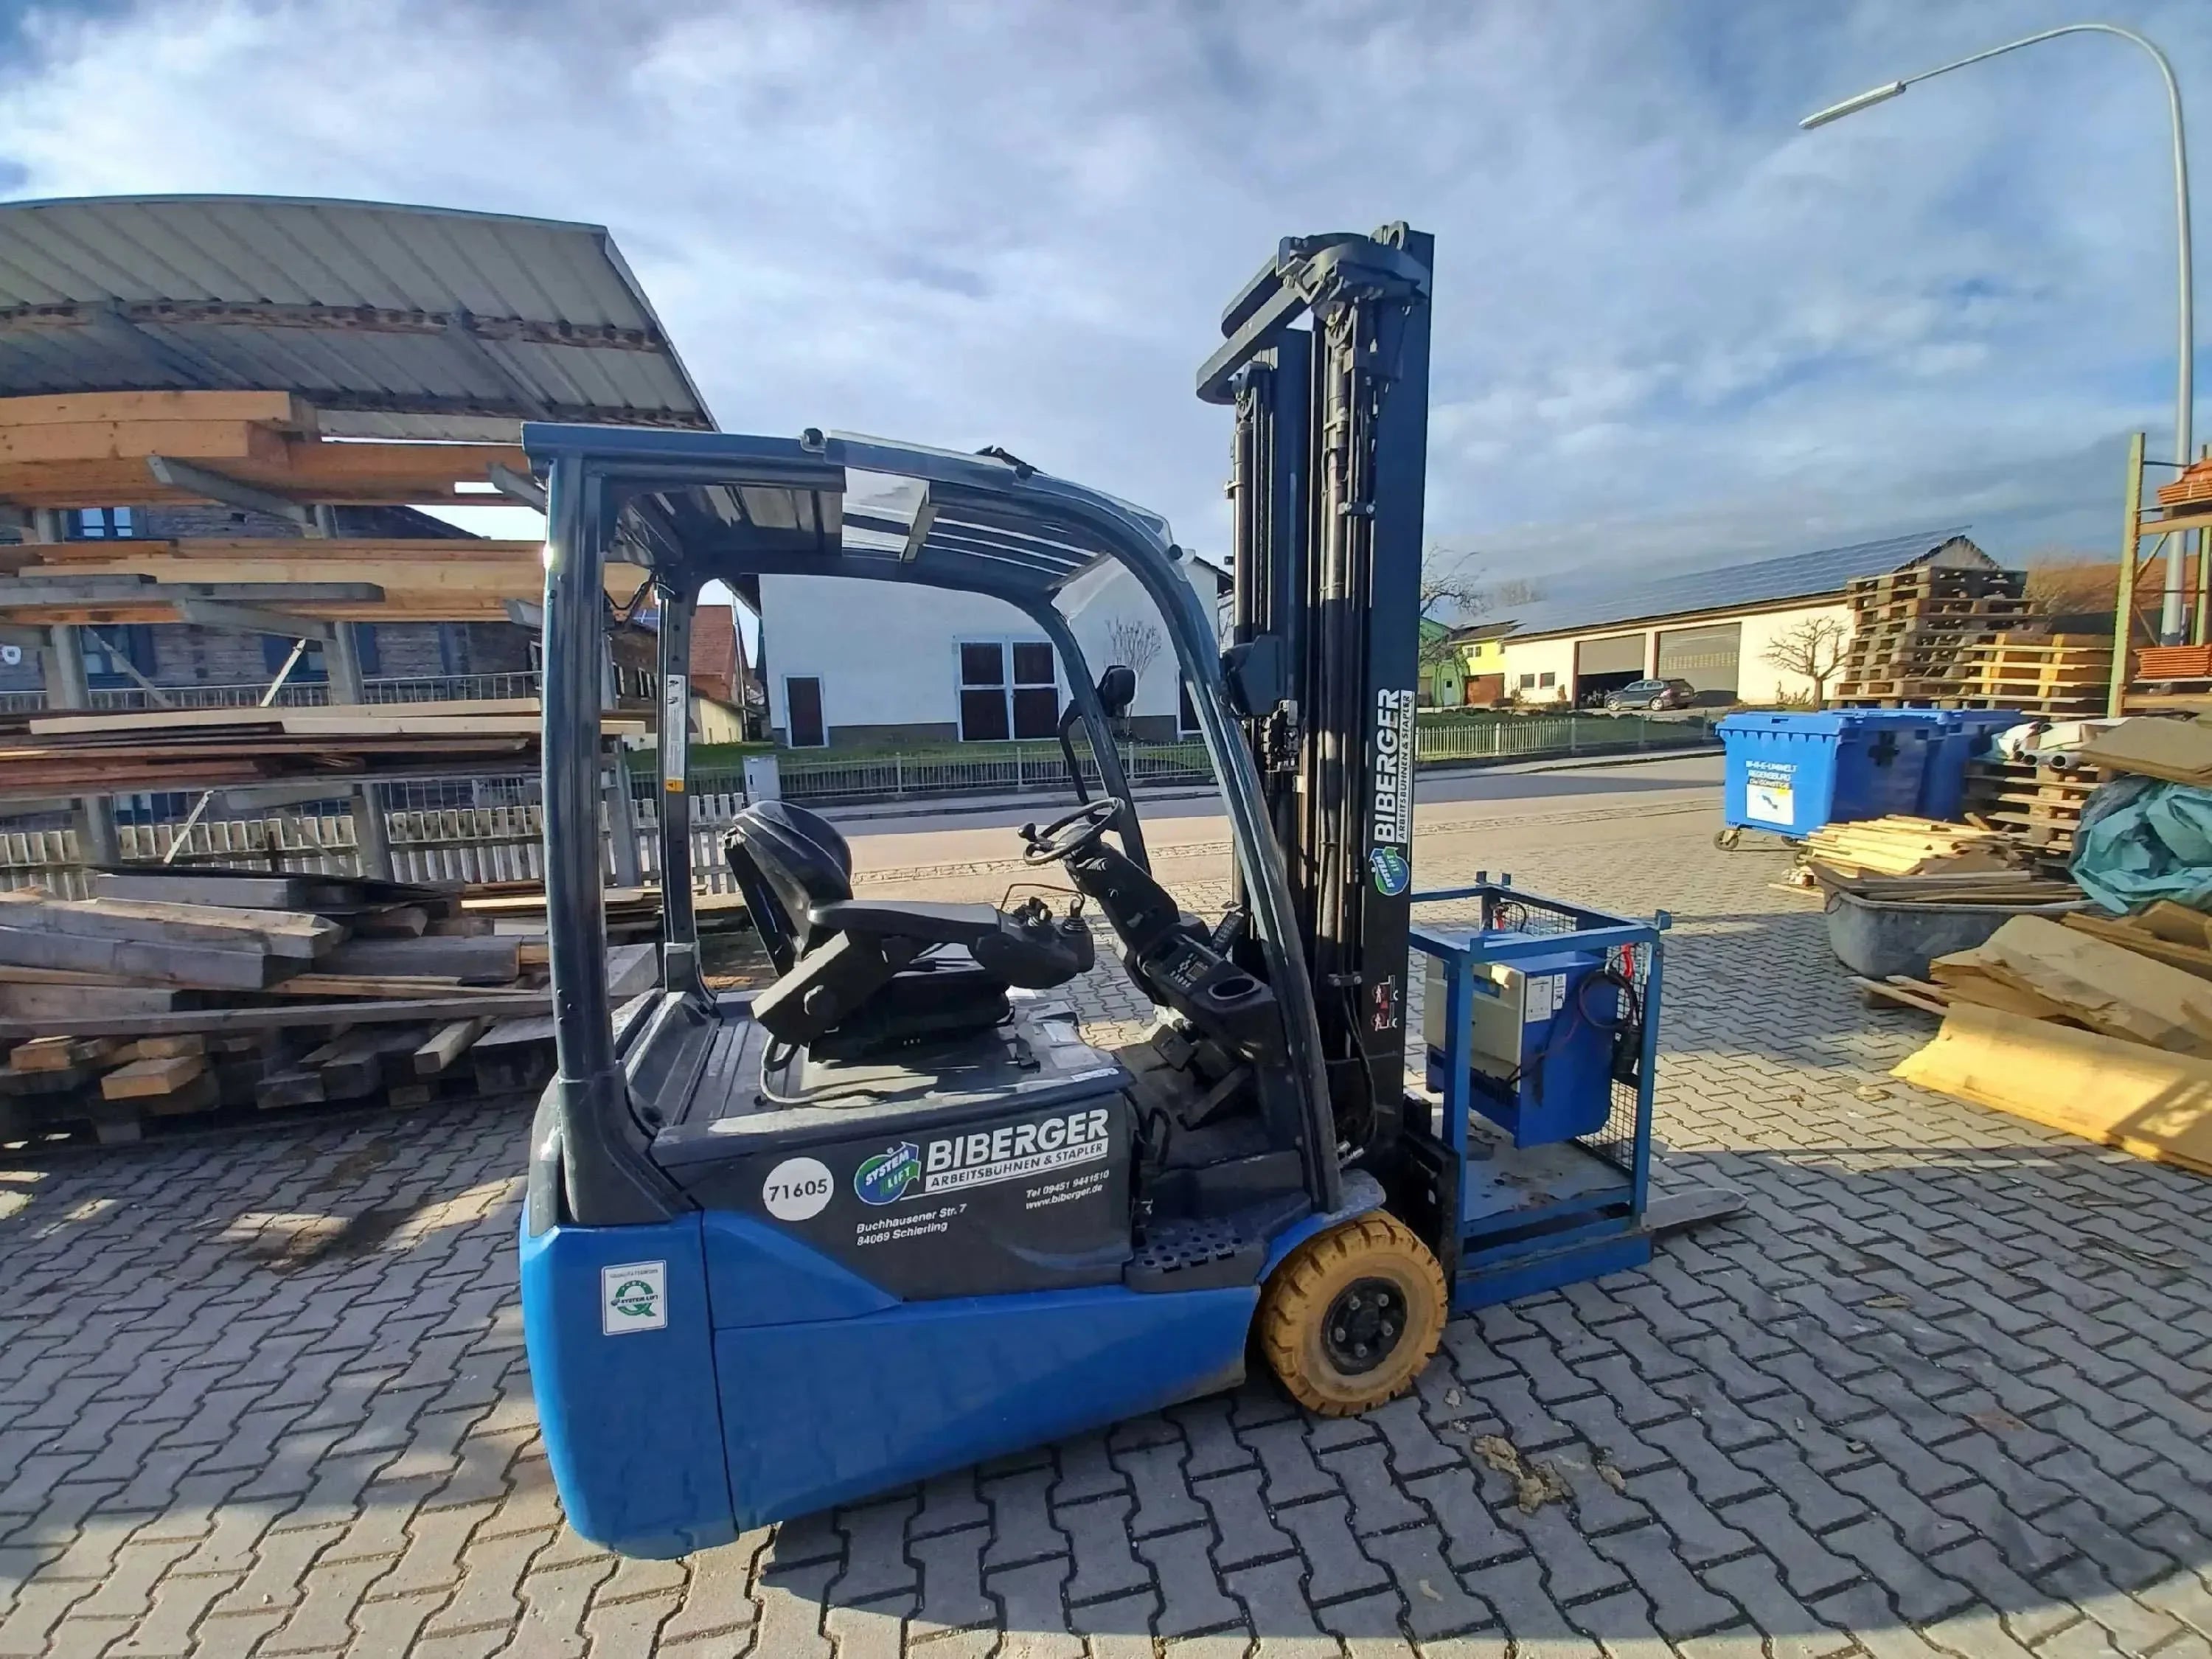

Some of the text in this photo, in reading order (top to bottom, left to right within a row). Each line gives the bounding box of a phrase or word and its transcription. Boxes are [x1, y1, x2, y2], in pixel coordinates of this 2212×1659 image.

[1402, 695, 1411, 740] STAPLER
[1402, 742, 1409, 751] &
[1374, 689, 1399, 842] BIBERGER
[1374, 855, 1395, 888] SYSTEM
[1386, 855, 1399, 872] LIFT
[927, 1109, 1109, 1172] BIBERGER
[1043, 1156, 1053, 1165] &
[1055, 1143, 1103, 1163] STAPLER
[866, 1150, 909, 1186] SYSTEM
[888, 1166, 911, 1189] LIFT
[769, 1179, 827, 1202] 71605
[1026, 1188, 1041, 1198] Tel
[1043, 1180, 1070, 1194] 09451
[1026, 1184, 1103, 1209] www.biberger.de
[856, 1203, 967, 1234] Buchhausener Str. 7
[856, 1221, 948, 1246] 84069 Schierling
